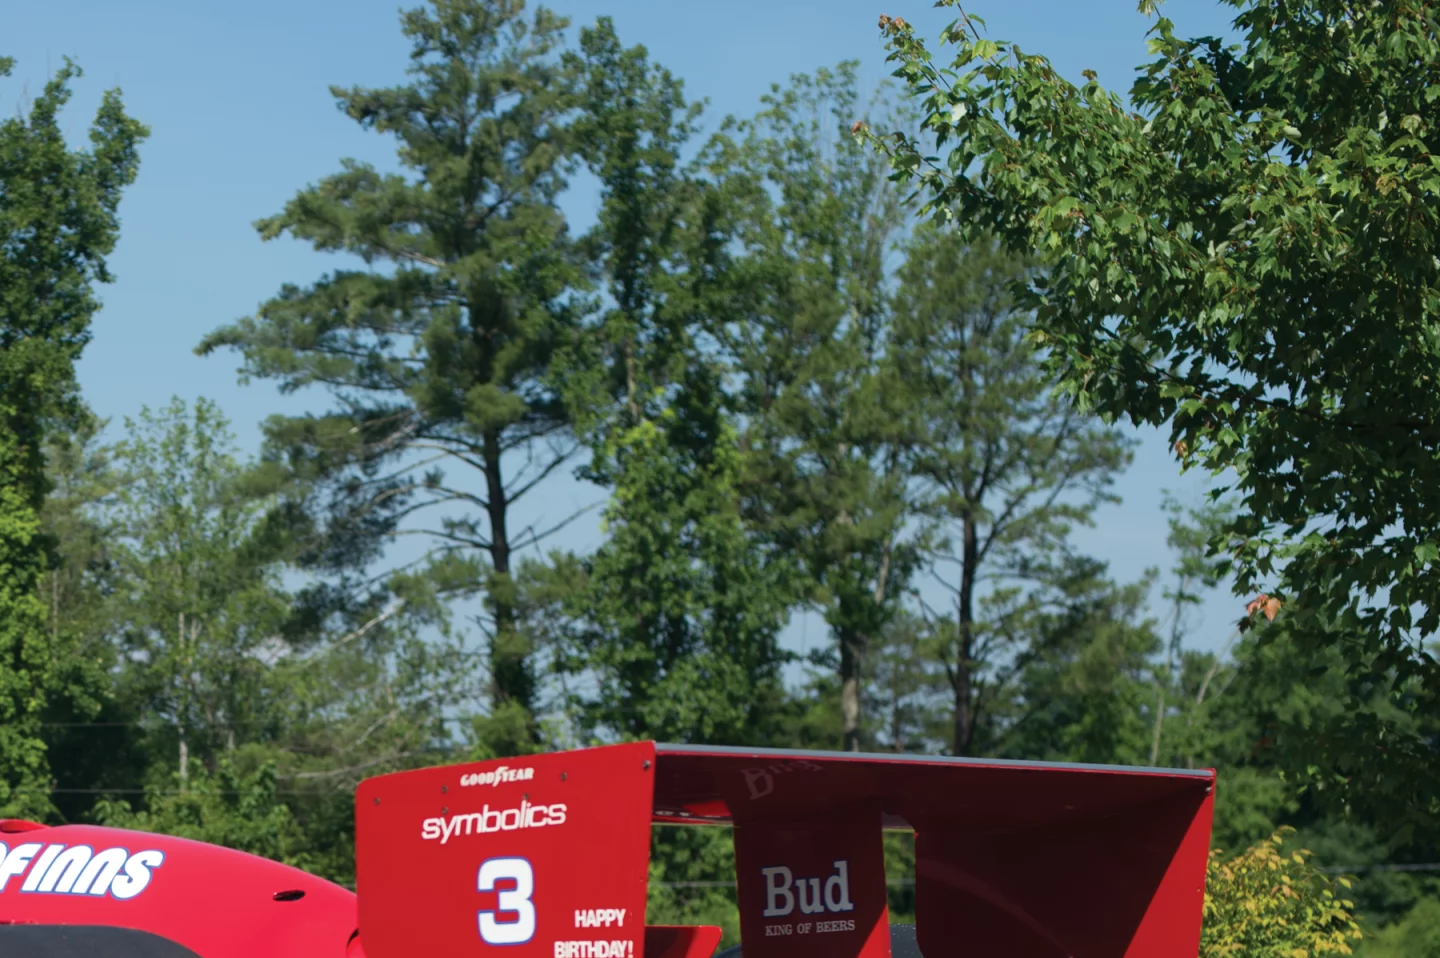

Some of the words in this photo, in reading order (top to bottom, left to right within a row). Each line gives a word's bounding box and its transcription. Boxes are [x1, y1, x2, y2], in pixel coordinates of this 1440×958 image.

[460, 766, 534, 787] GOODYEAR
[421, 800, 567, 844] symbolics
[19, 843, 165, 901] INNS
[477, 855, 536, 947] 3
[761, 859, 854, 918] Bud
[574, 908, 627, 928] HAPPY
[765, 924, 793, 936] KING
[797, 922, 812, 934] OF
[816, 919, 856, 933] BEERS
[554, 940, 634, 958] BIRTHDAY!
